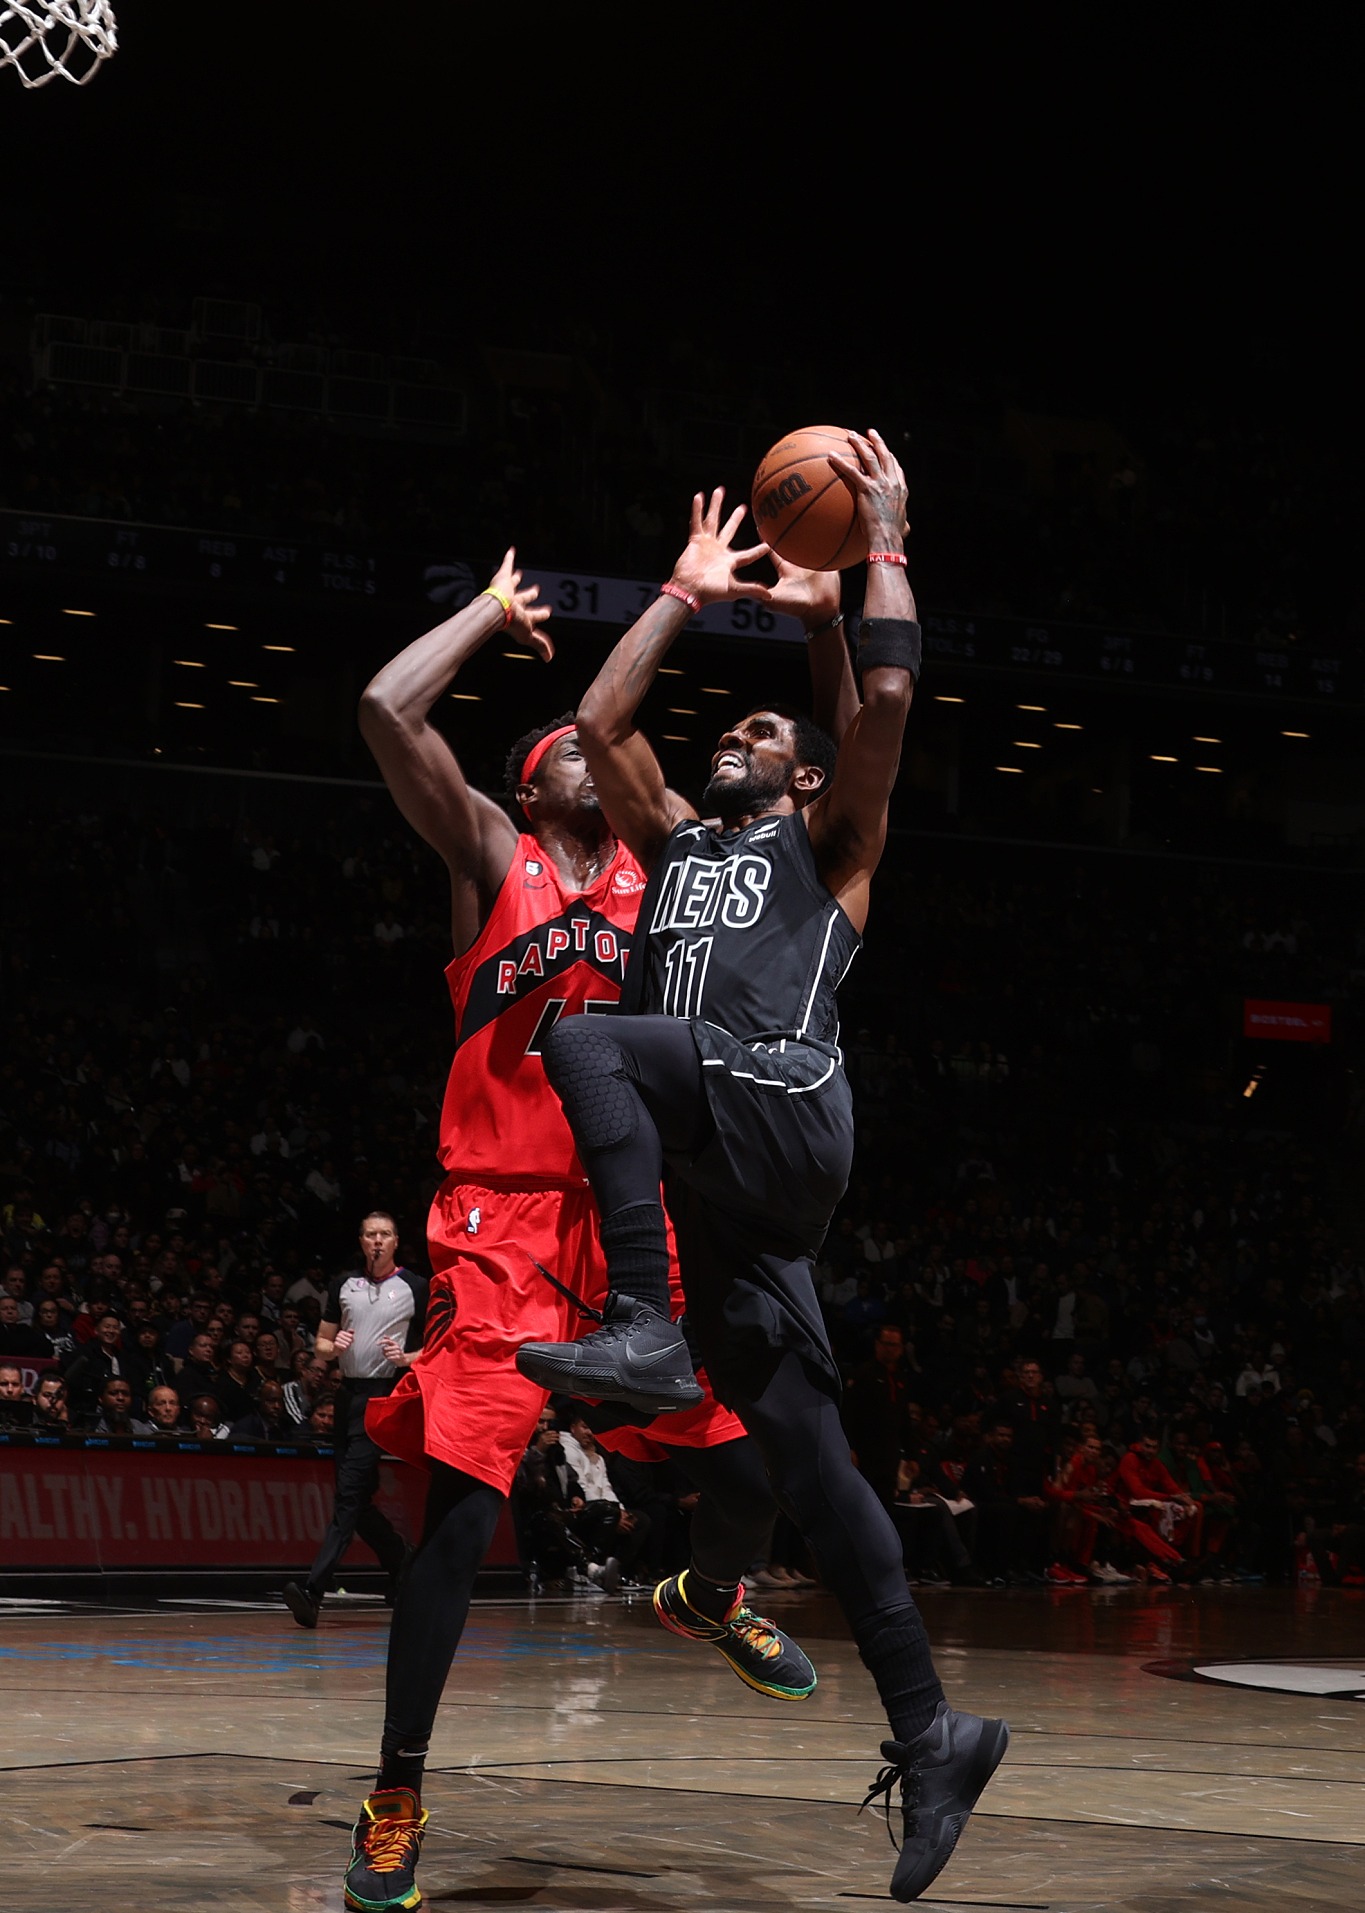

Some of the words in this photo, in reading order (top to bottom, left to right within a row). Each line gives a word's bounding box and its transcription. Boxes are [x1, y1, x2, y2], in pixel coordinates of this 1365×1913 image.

[116, 530, 139, 546] FT
[262, 546, 298, 563] AST
[274, 569, 286, 584] 4
[557, 579, 599, 614] 31
[731, 598, 777, 633] 56
[612, 885, 630, 895] Sun
[663, 936, 714, 1019] 11
